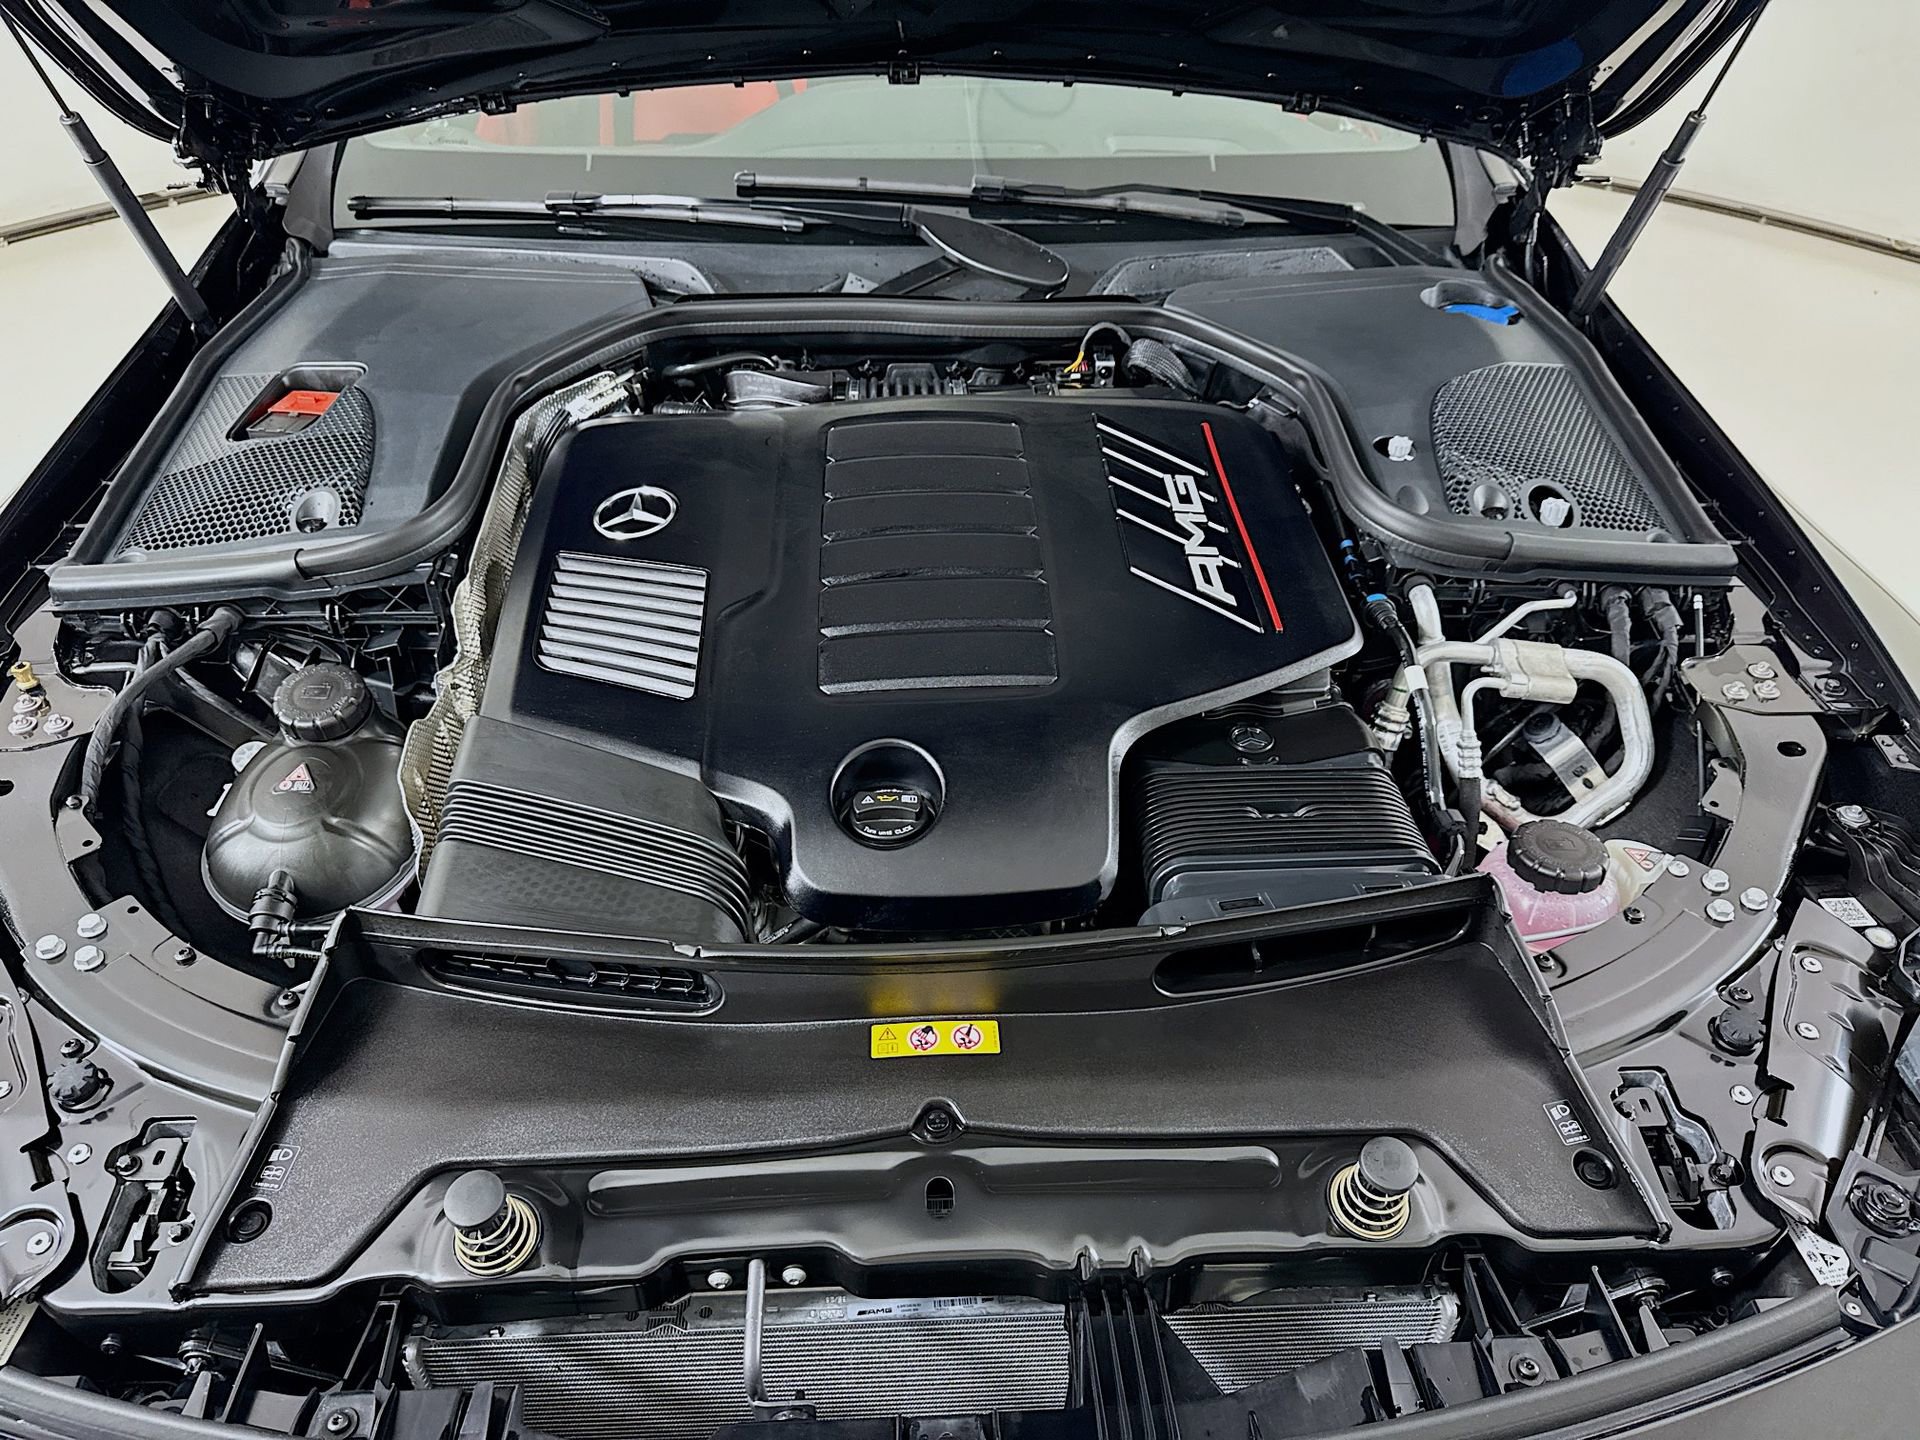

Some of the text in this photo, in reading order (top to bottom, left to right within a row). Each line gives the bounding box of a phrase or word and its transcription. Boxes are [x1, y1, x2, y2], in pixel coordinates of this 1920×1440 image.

[1163, 474, 1237, 606] AMG
[864, 826, 877, 834] Turn
[894, 825, 914, 835] CLICK
